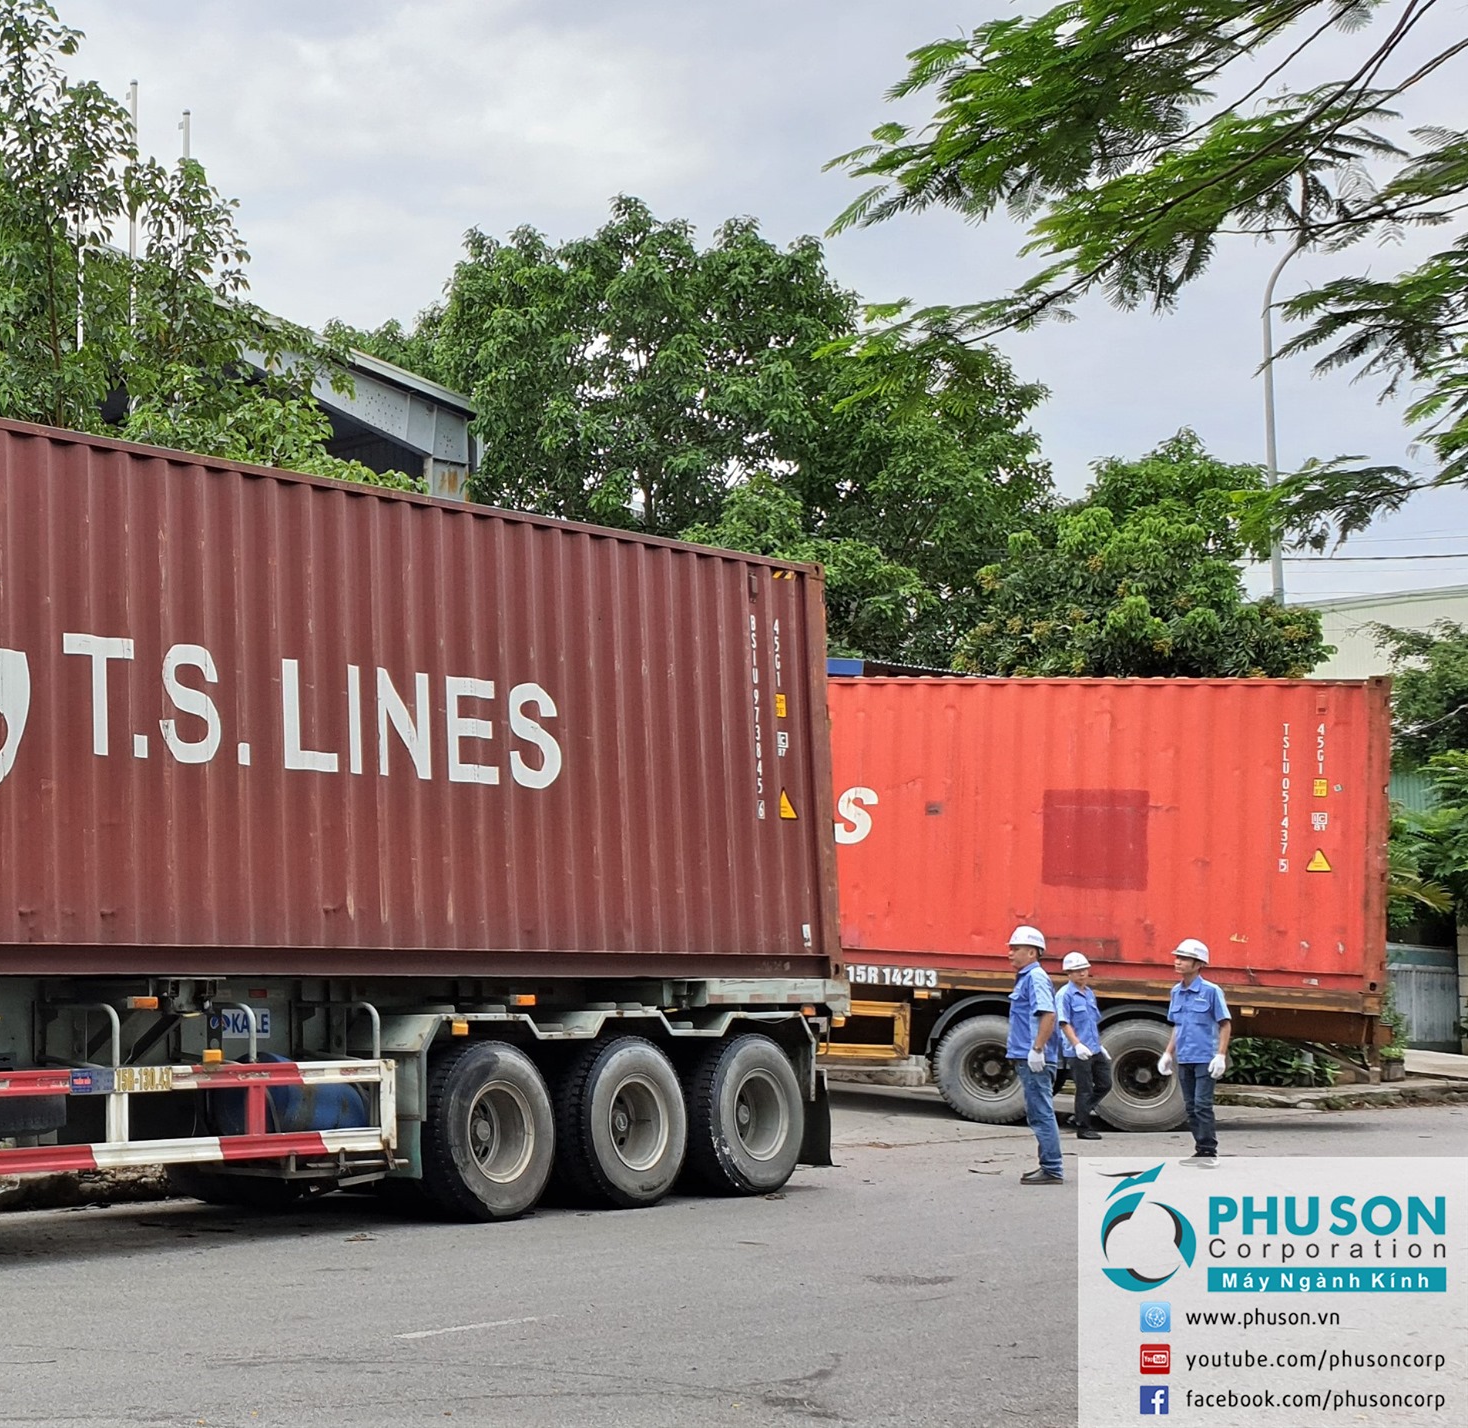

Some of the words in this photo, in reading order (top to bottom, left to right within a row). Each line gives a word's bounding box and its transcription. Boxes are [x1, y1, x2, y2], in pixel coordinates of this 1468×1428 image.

[749, 614, 759, 685] BSIU
[63, 632, 251, 766] T.S.
[282, 658, 562, 789] LINES
[752, 688, 763, 794] 973845
[1282, 722, 1290, 775] TSLU
[1316, 722, 1325, 775] 45G1
[834, 786, 879, 845] S
[1280, 777, 1290, 854] 051437
[846, 965, 879, 984] 15R
[882, 967, 937, 988] 14203
[232, 1012, 269, 1034] KAE
